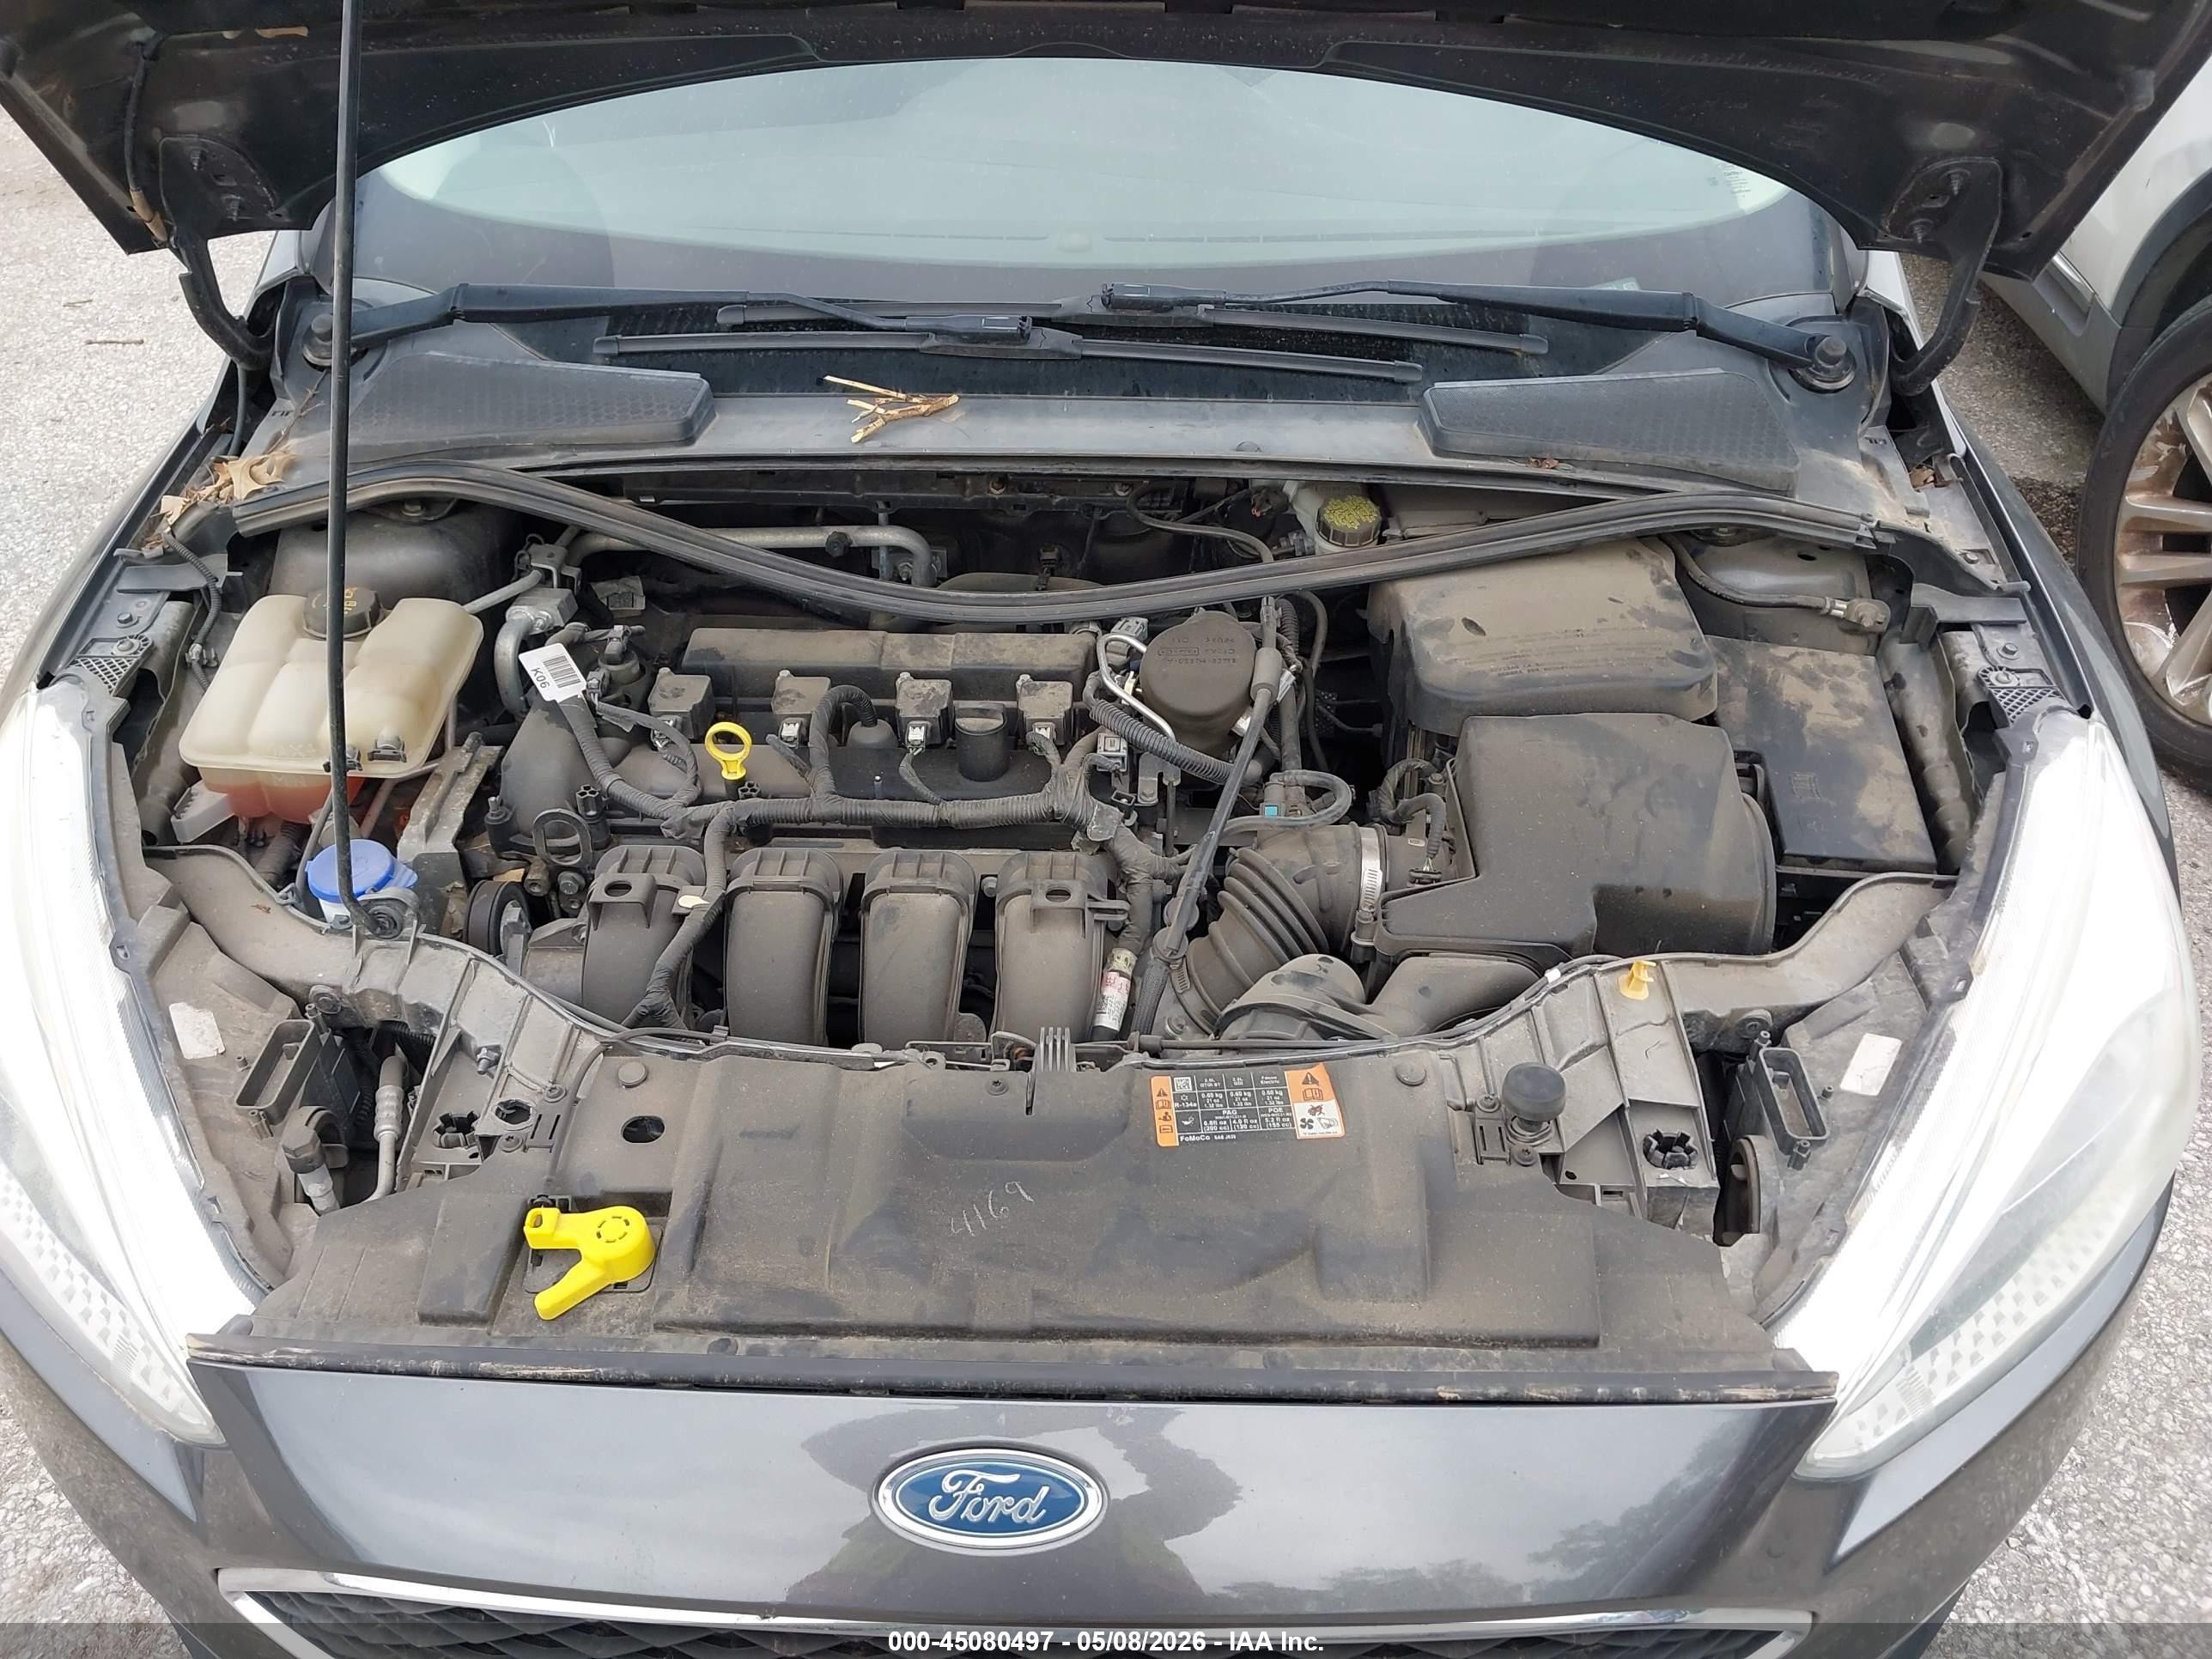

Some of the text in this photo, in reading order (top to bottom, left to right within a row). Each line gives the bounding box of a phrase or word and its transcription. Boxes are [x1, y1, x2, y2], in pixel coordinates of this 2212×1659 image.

[529, 667, 550, 689] K06
[949, 1182, 1034, 1237] 4169
[928, 1469, 1050, 1523] Ford
